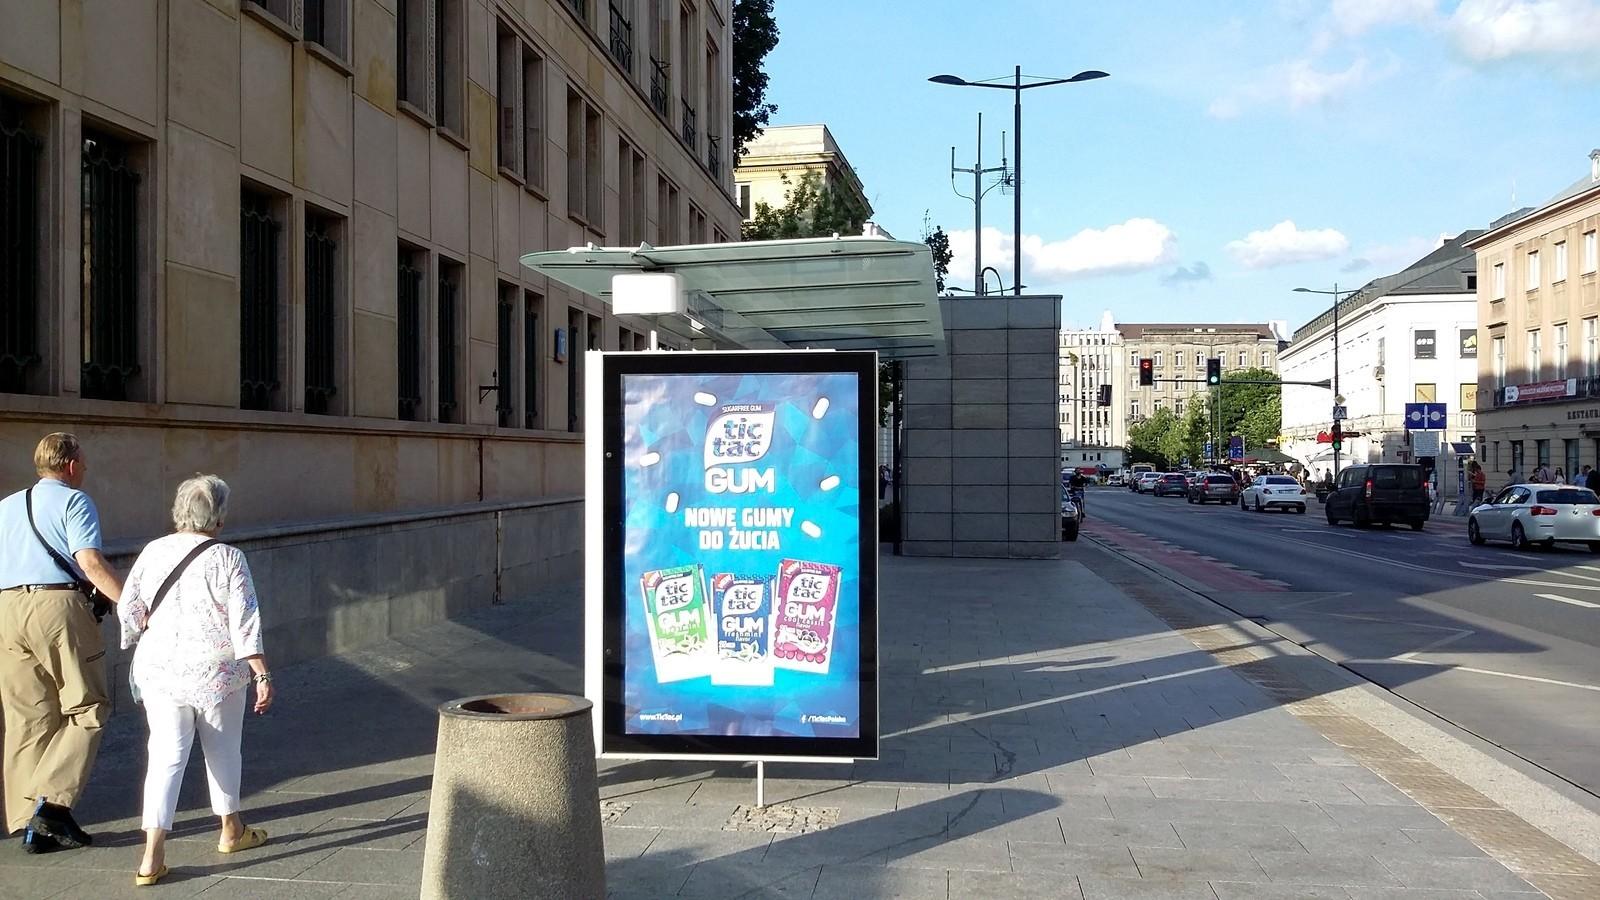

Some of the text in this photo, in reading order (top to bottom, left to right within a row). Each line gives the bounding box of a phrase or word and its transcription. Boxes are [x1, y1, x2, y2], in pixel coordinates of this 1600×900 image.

[723, 417, 763, 440] tic
[713, 437, 761, 457] tac
[705, 466, 775, 494] GUM
[684, 507, 795, 528] NOWE GUMY
[699, 526, 781, 550] DO ŻUCIA
[664, 581, 689, 596] tic
[792, 585, 821, 600] tac
[800, 576, 823, 590] tic
[660, 593, 689, 607] tac
[734, 586, 757, 600] tic
[728, 599, 757, 611] tac
[784, 602, 826, 622] GUM
[657, 607, 701, 632] GUM
[721, 615, 764, 634] GUM
